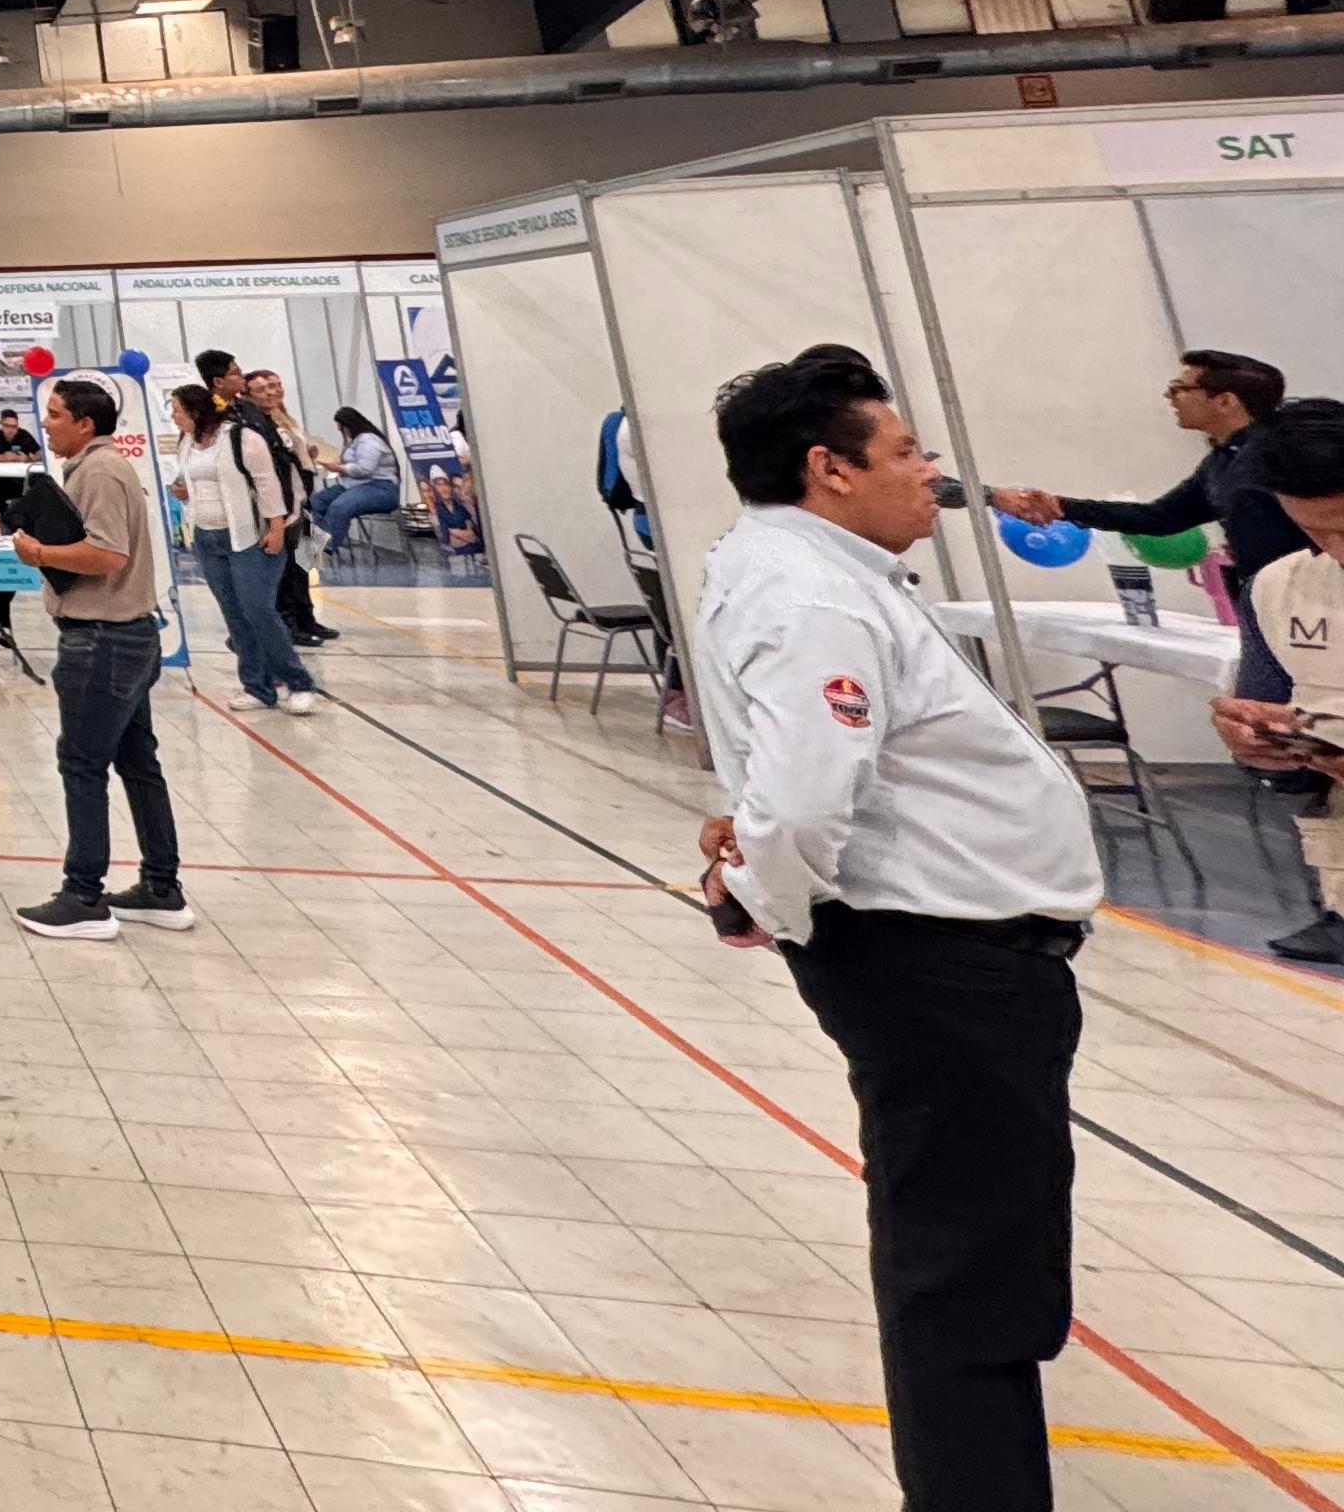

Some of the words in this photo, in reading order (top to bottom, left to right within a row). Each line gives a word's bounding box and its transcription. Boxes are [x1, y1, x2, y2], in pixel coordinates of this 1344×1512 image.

[1216, 133, 1295, 160] SAT
[237, 276, 251, 287] DE
[254, 276, 340, 287] ESPECIALIDADES
[409, 273, 440, 284] CAN
[46, 282, 101, 292] NACIONAL
[1289, 616, 1328, 642] M
